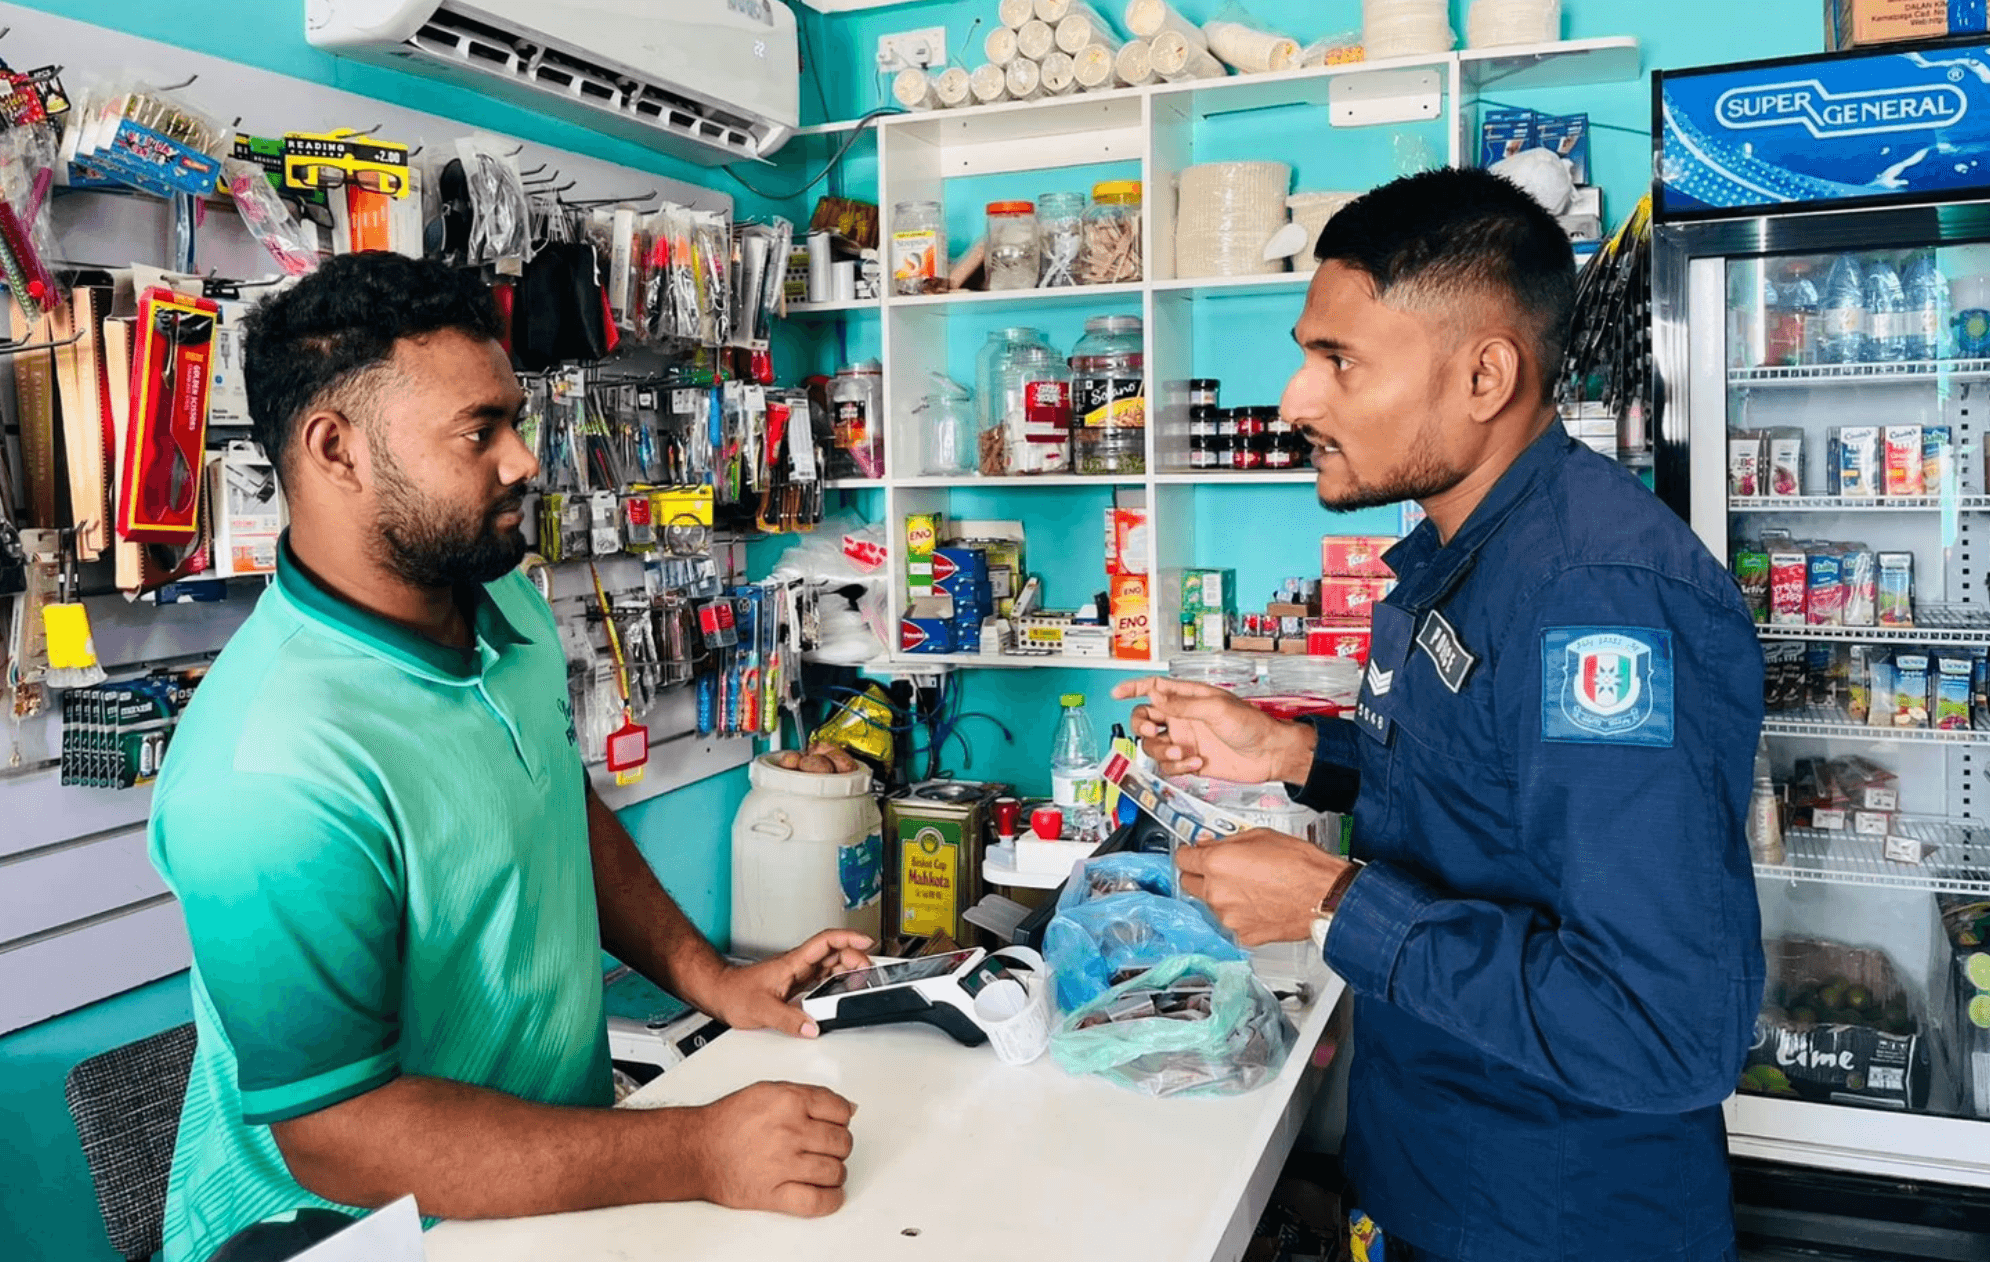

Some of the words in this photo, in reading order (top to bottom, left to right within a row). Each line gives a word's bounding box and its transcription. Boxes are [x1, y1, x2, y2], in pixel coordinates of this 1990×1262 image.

[1727, 92, 1824, 126] SUPER
[1822, 96, 1954, 125] GENERAL
[288, 140, 345, 151] READING
[910, 528, 932, 541] ENO
[1124, 587, 1142, 596] ENO
[1119, 615, 1148, 630] ENO
